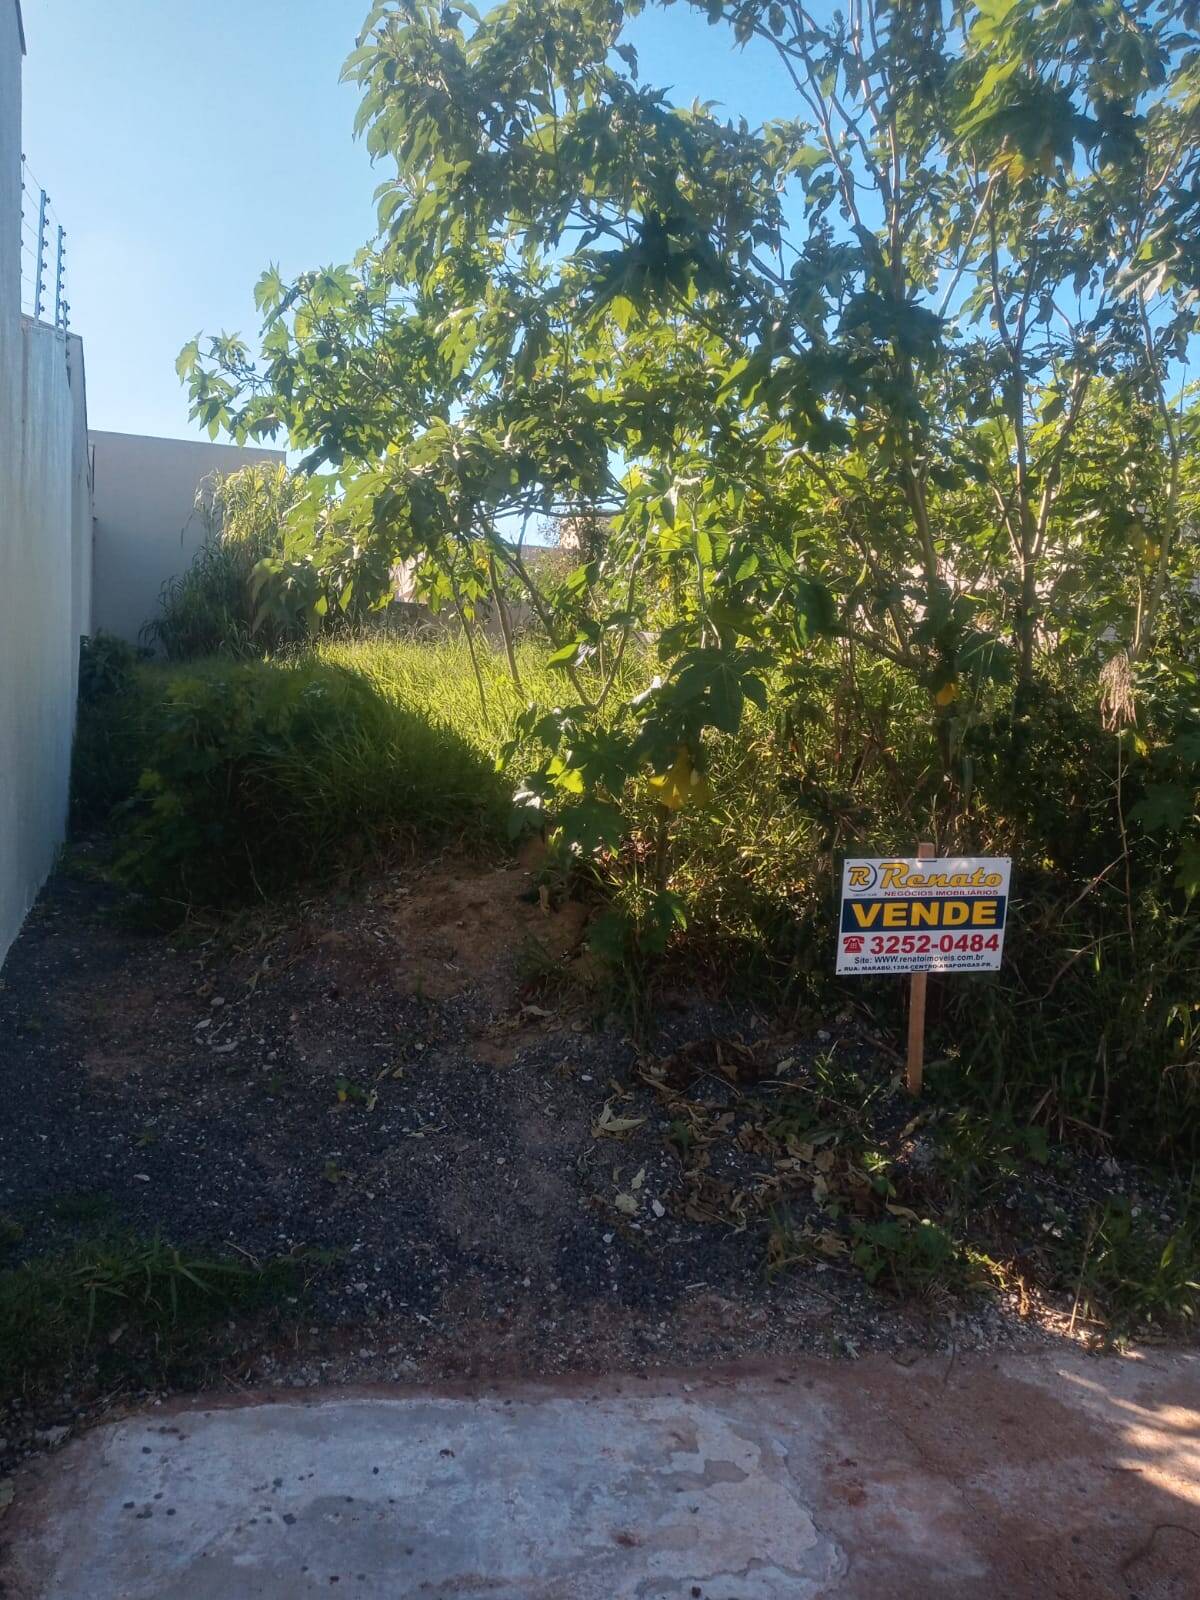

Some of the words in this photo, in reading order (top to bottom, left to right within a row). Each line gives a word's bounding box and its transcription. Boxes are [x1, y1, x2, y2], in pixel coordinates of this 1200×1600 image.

[878, 863, 1003, 889] Renato
[851, 901, 998, 928] VENDE
[870, 934, 1000, 955] 3252-0484
